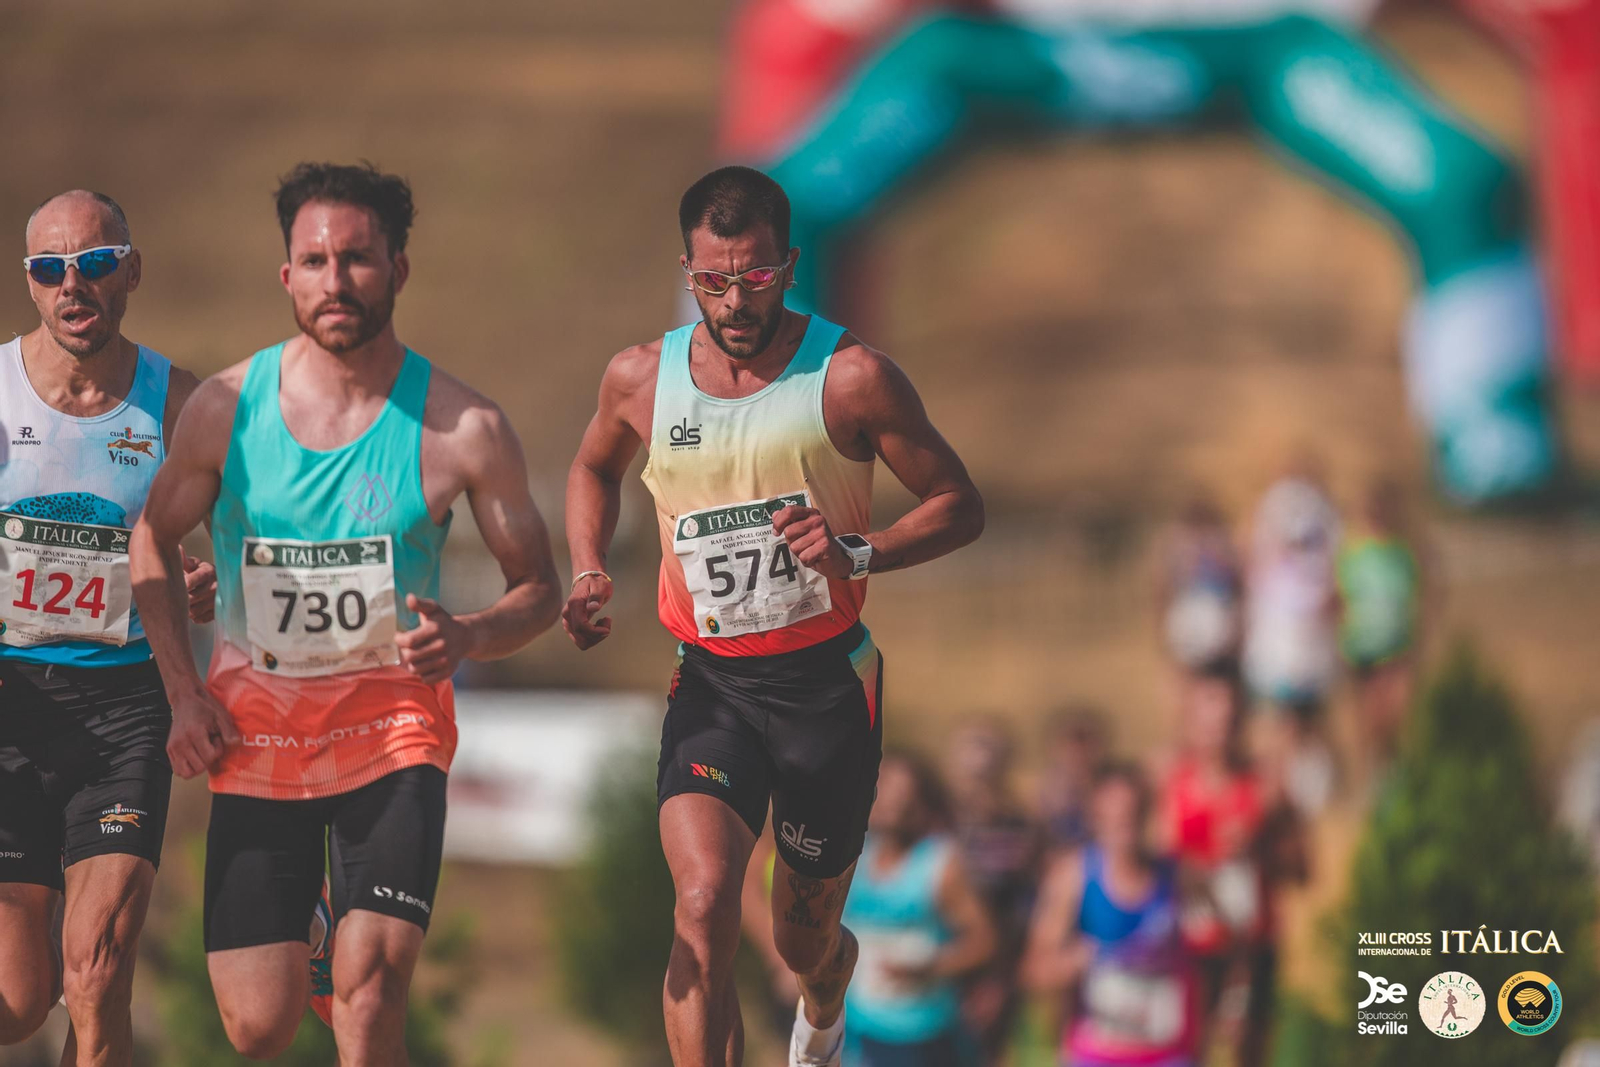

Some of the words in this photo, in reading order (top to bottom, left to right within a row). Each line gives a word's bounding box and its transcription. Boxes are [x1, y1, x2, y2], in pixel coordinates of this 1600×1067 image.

[132, 433, 161, 441] ATLETISMO
[108, 450, 138, 467] Viso
[707, 508, 772, 530] ITÁLICA
[33, 524, 100, 546] ITÁLICA
[15, 546, 40, 555] MANUEL
[722, 537, 768, 549] INDEPENDIENTE
[39, 557, 88, 567] INDEPENDIENTE
[705, 543, 798, 597] 574
[13, 569, 105, 618] 124
[272, 590, 366, 633] 730
[710, 767, 728, 780] RUN
[100, 823, 123, 834] Viso
